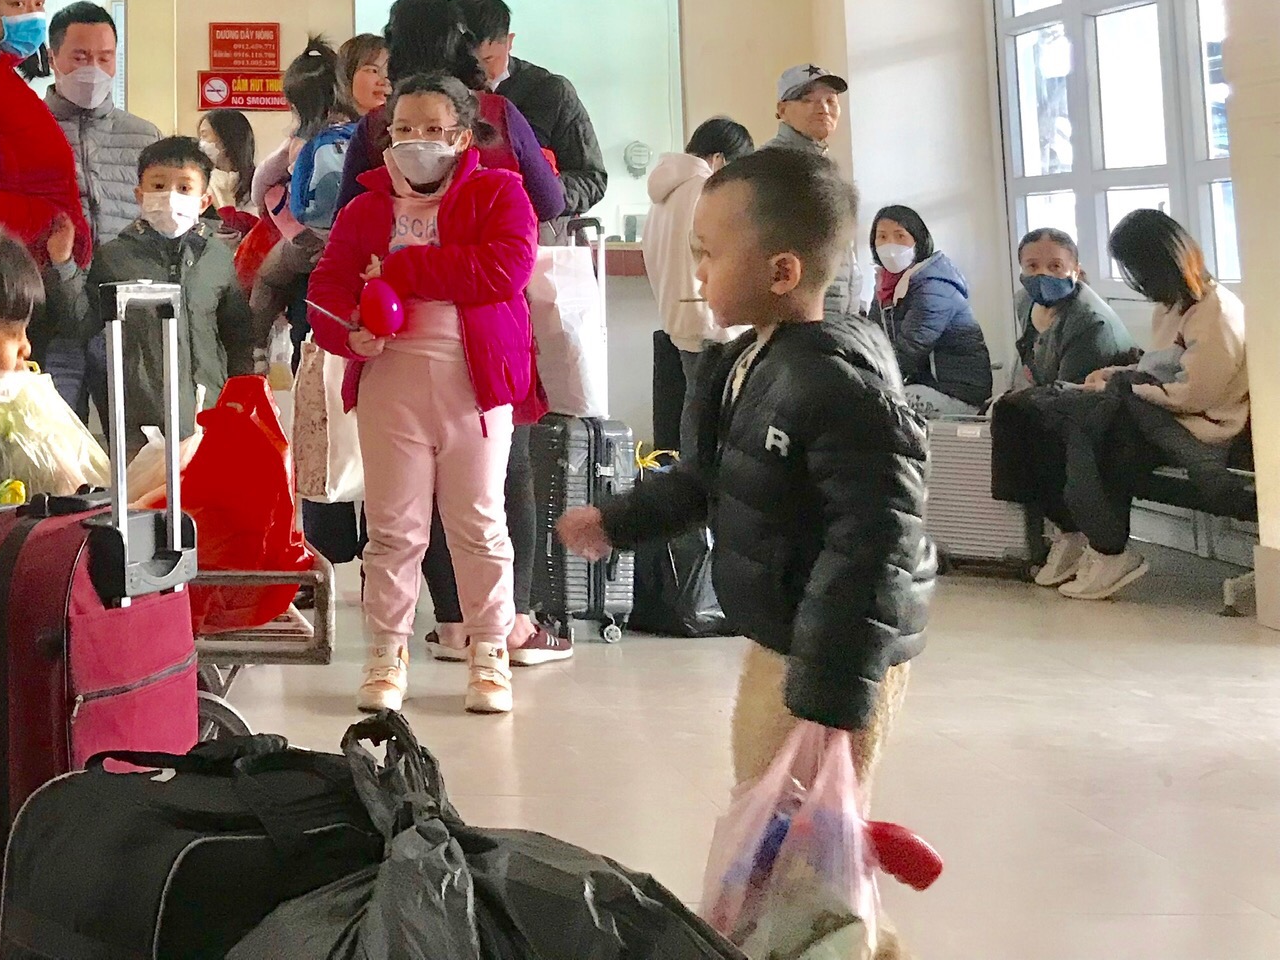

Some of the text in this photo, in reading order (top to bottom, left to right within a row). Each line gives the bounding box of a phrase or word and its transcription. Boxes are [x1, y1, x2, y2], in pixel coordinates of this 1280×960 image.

[266, 77, 284, 92] THU
[231, 96, 286, 106] NO SMOKING
[765, 425, 791, 457] R
